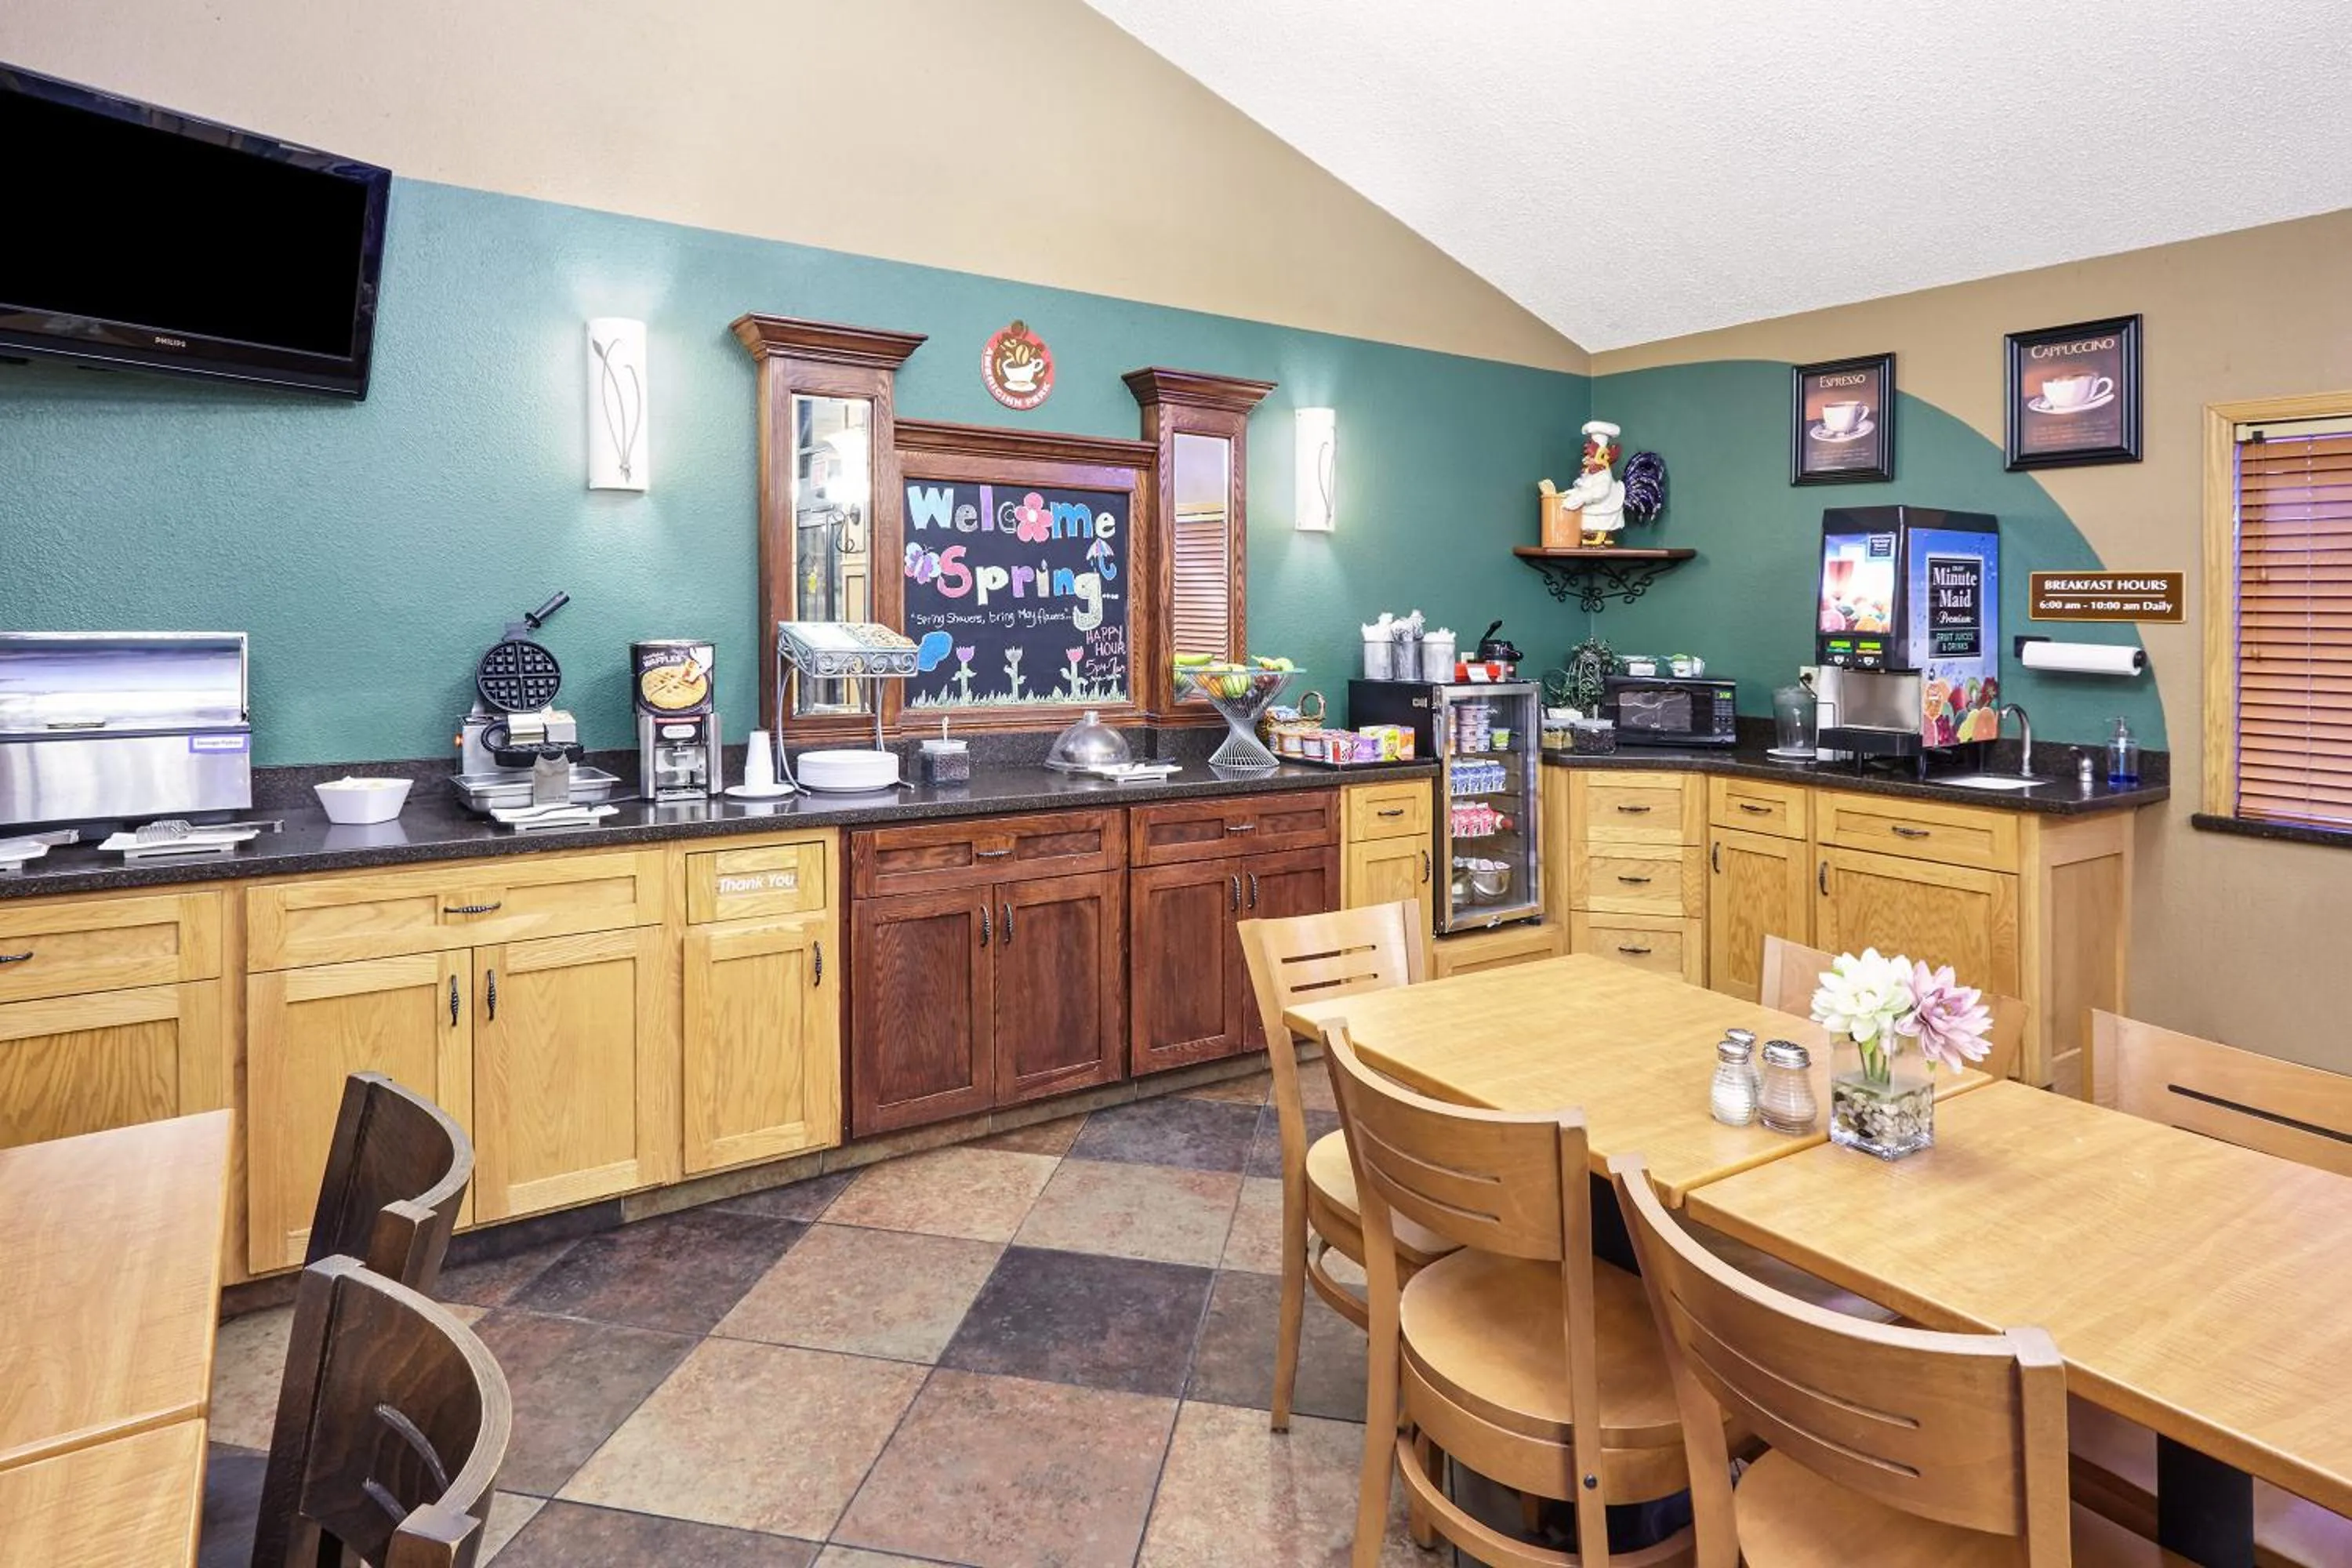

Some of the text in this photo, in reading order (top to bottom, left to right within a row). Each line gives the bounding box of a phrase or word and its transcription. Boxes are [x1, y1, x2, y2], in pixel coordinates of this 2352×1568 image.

[154, 336, 186, 347] PHILIPS
[2031, 338, 2115, 358] CAPPUCCINO
[1820, 374, 1866, 388] ESPRESSO
[1932, 567, 1978, 586] Minute
[2044, 579, 2168, 590] BREAKFAST HOURS
[1939, 589, 1973, 608] Maid
[2039, 601, 2063, 609] 6:00
[2091, 601, 2121, 610] 10:00
[2143, 601, 2173, 613] Daily
[989, 611, 1015, 628] bring
[1018, 608, 1036, 628] May
[1086, 625, 1123, 645] HAPPY
[1095, 641, 1127, 656] HOUR
[720, 873, 795, 894] Thank You
